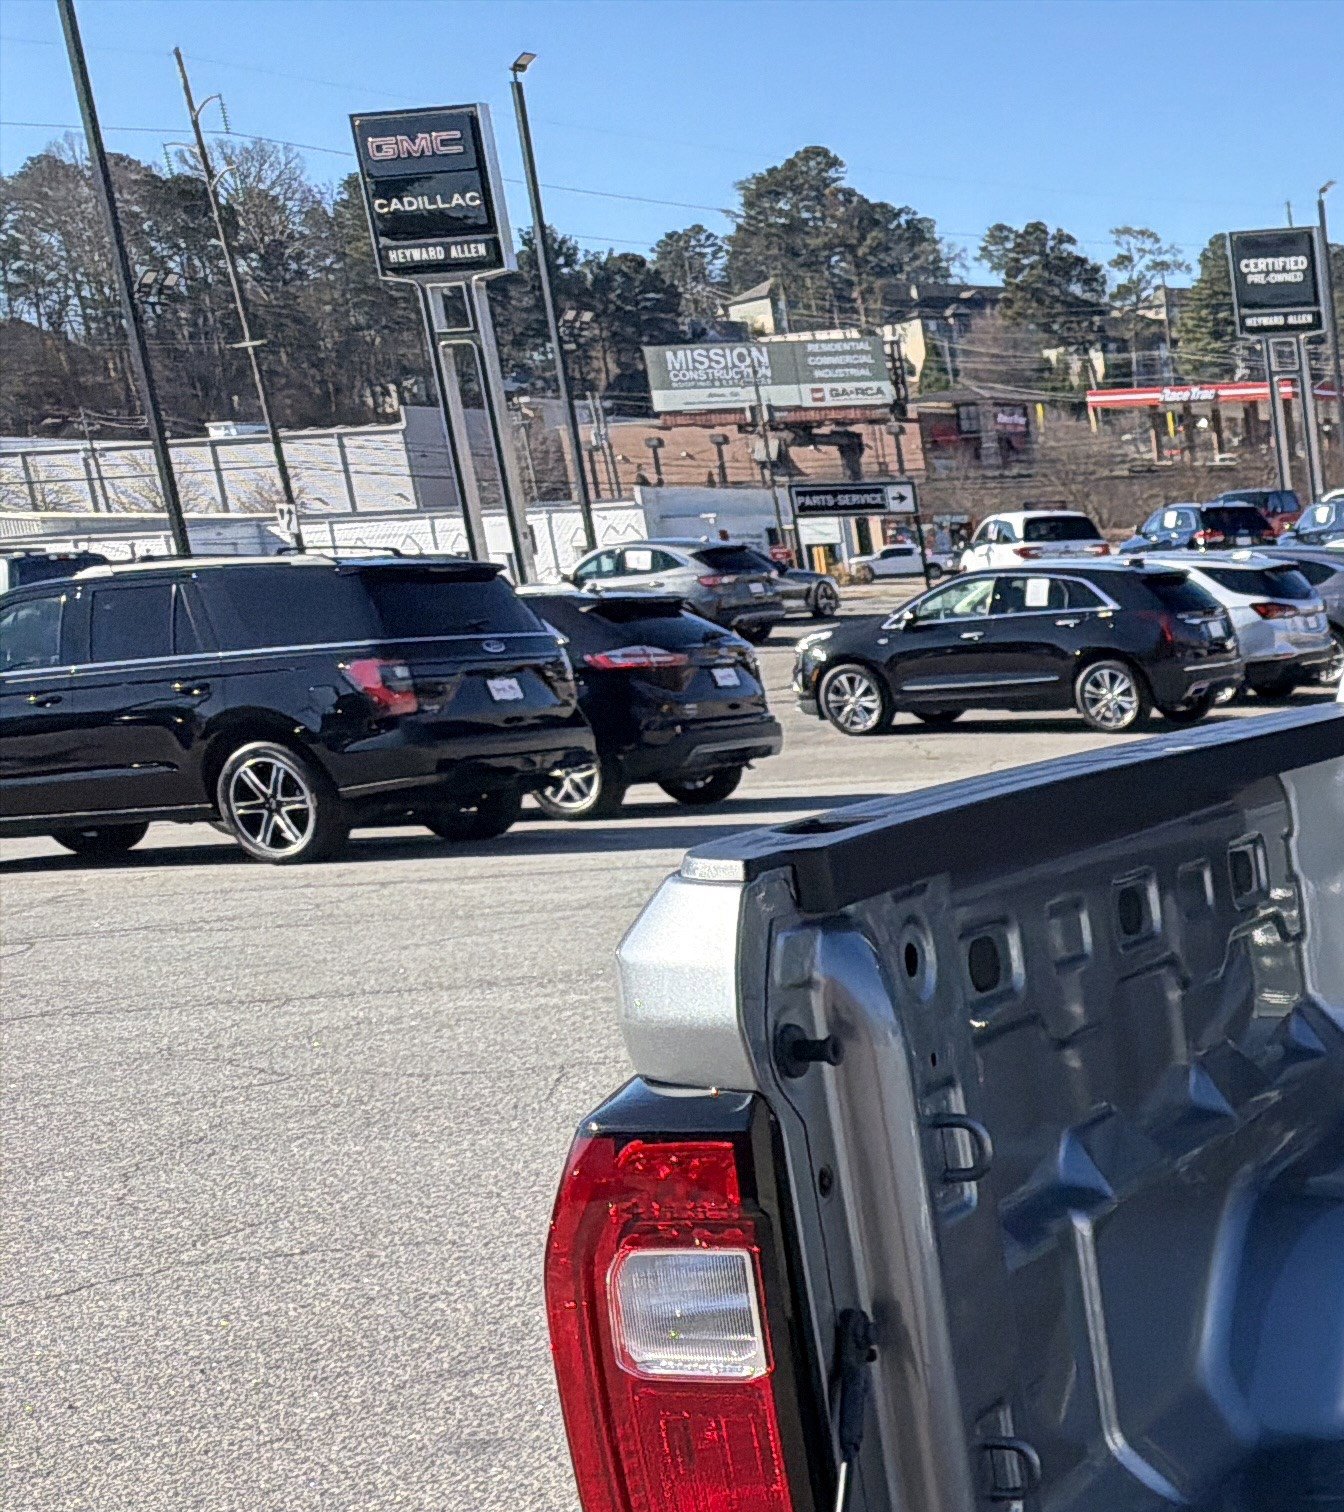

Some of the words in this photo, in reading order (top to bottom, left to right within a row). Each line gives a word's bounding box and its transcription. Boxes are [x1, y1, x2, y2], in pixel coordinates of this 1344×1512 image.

[367, 131, 464, 161] GMC
[373, 192, 481, 214] CADILLAC
[389, 246, 445, 263] HEYWARD
[450, 243, 487, 258] ALLEN
[1240, 255, 1308, 274] CERTIFIED
[1246, 271, 1304, 284] PRE-OWNED
[665, 346, 770, 371] MISSION
